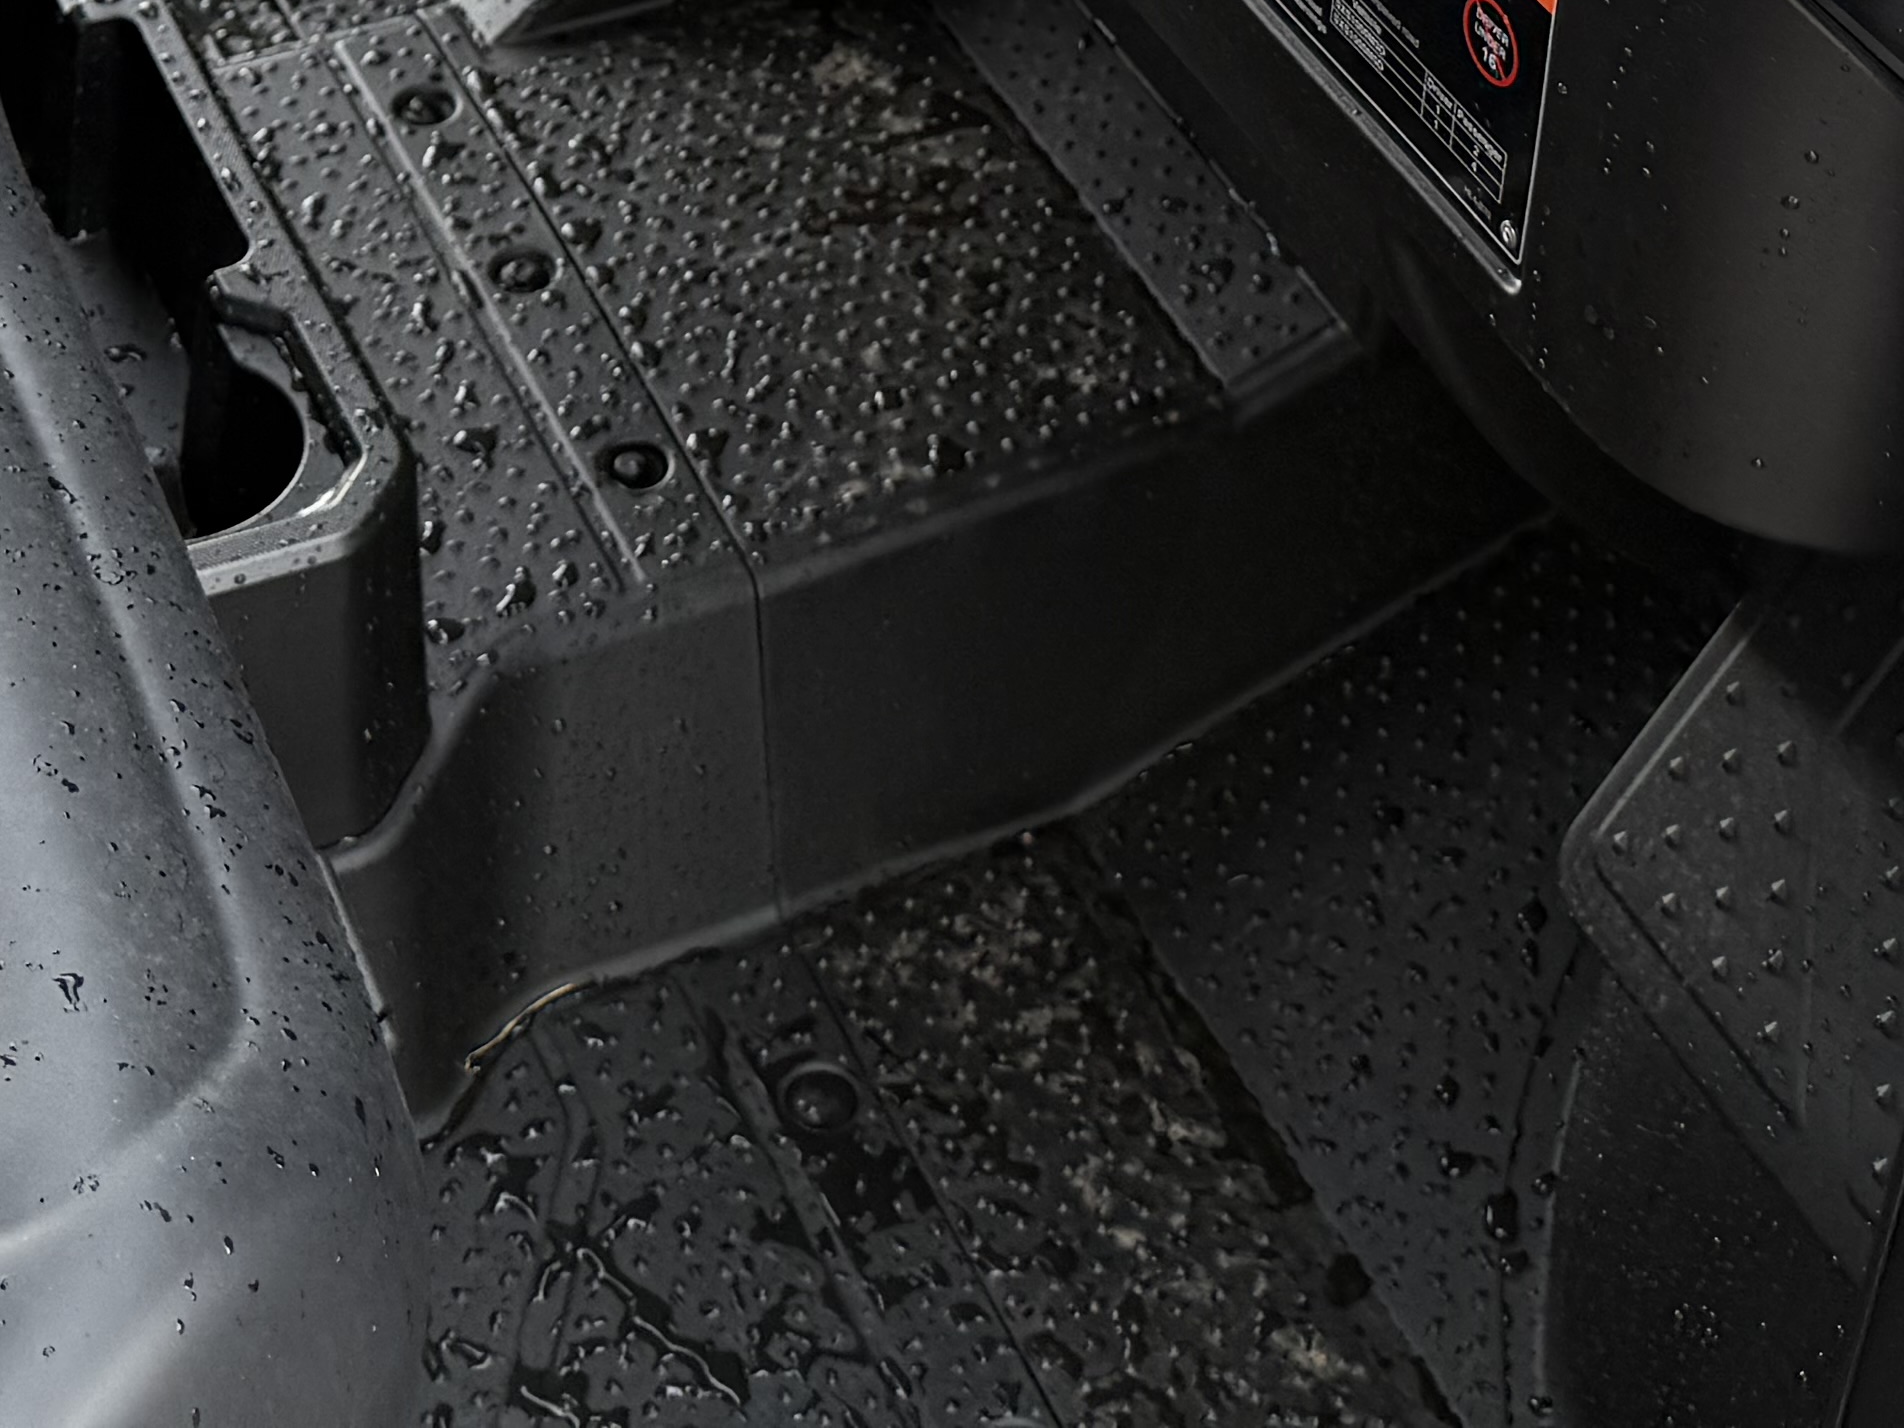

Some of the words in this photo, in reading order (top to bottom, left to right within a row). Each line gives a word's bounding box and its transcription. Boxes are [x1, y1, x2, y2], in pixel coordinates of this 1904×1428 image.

[1474, 21, 1505, 60] UNDER
[1475, 5, 1508, 47] DRIVER
[1481, 46, 1498, 70] 16
